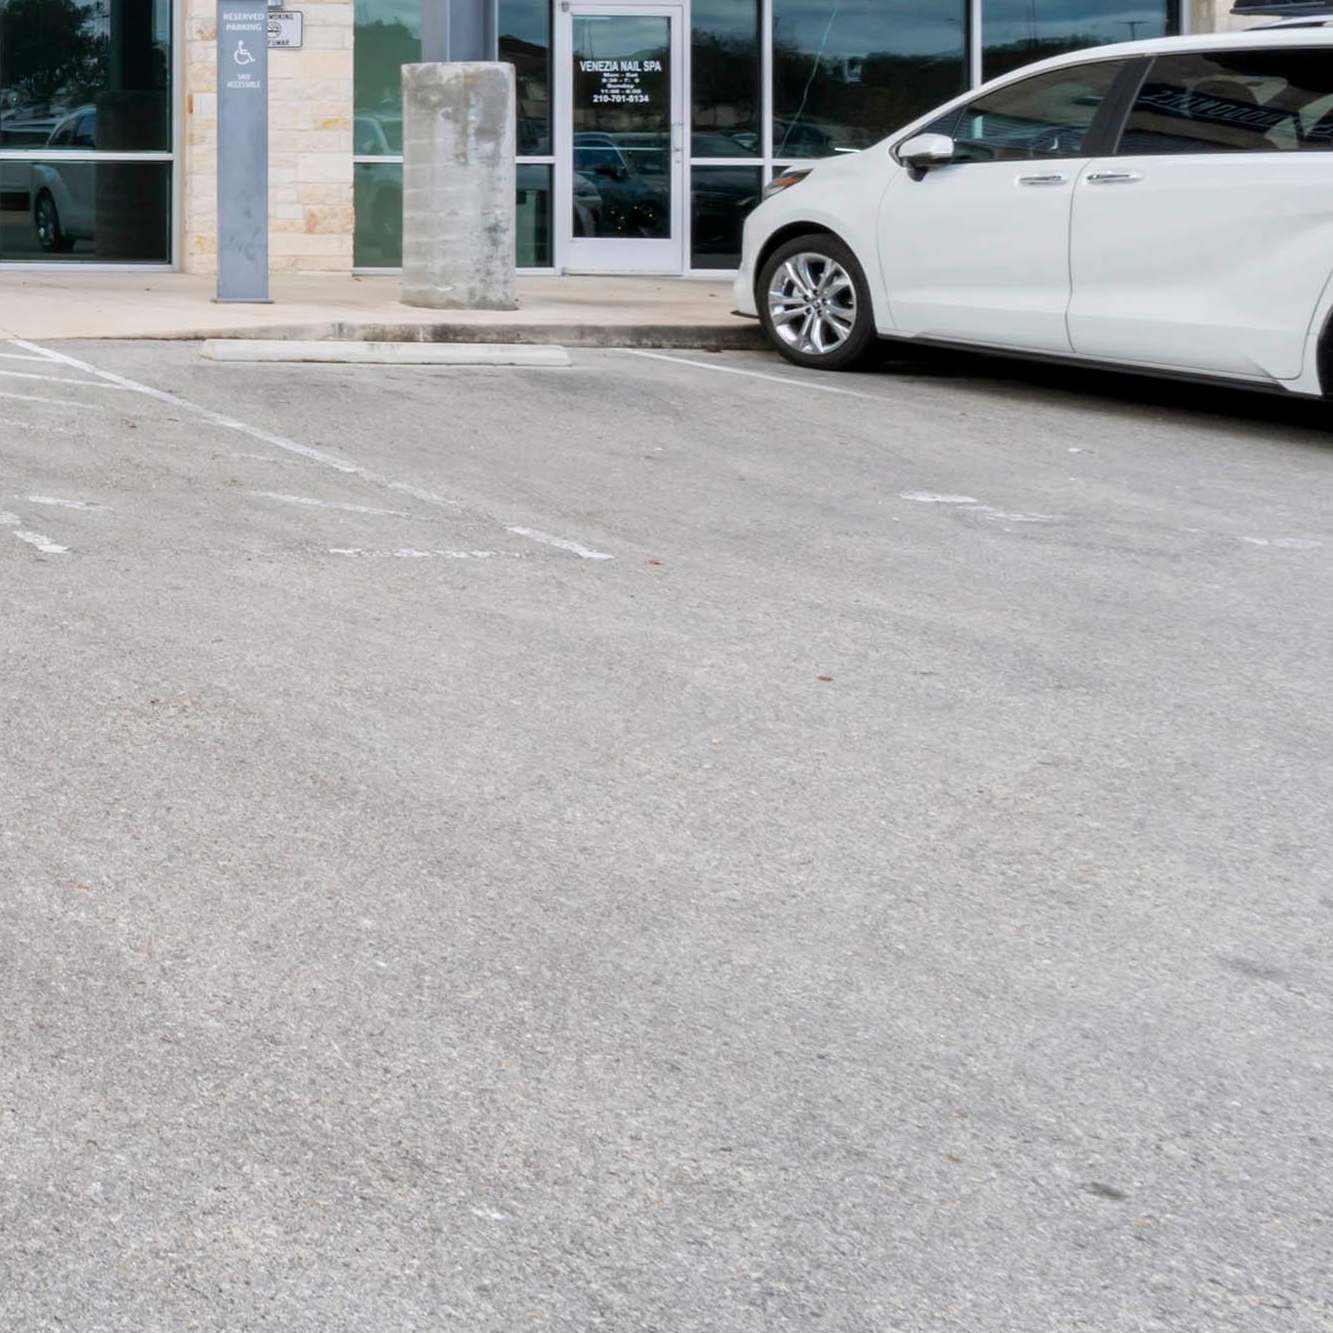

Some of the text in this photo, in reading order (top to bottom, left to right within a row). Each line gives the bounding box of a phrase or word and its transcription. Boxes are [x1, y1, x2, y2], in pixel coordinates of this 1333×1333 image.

[223, 12, 265, 21] RESERVED
[225, 23, 263, 31] PARKING
[579, 60, 662, 72] VENEZIA NAIL SPA
